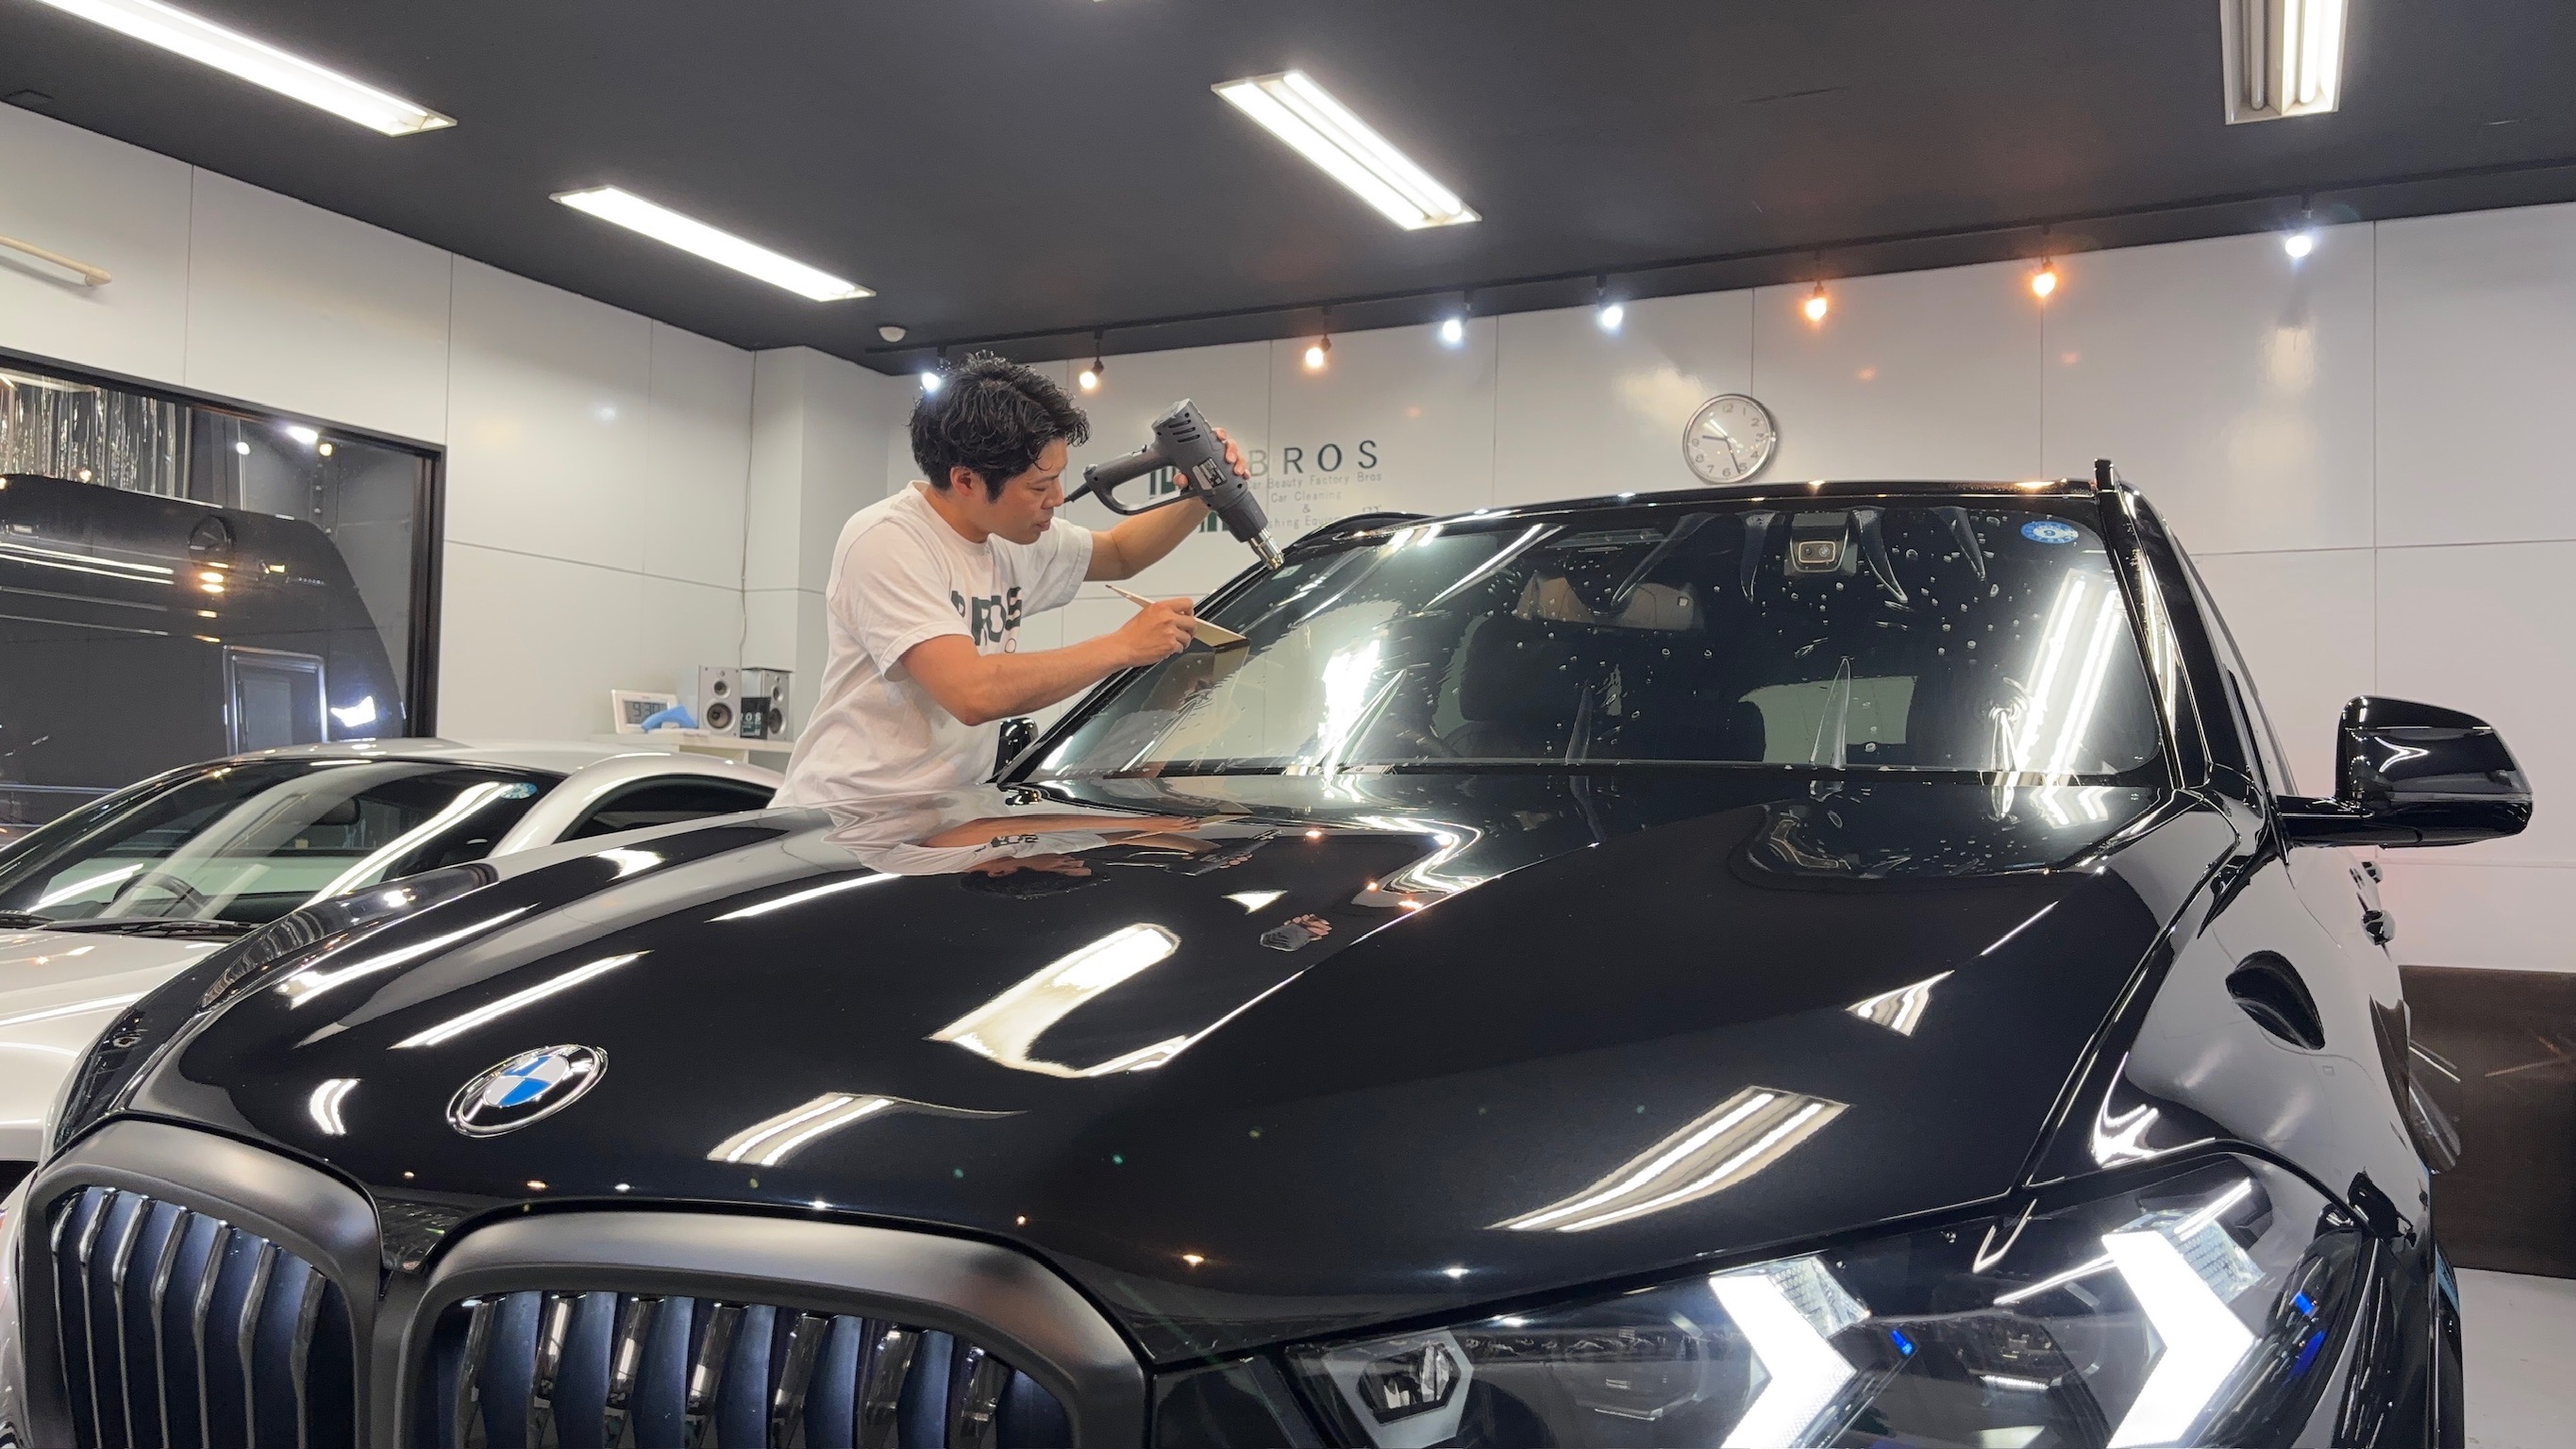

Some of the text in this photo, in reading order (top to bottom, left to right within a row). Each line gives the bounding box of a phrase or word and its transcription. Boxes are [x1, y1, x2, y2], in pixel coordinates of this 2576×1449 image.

[1750, 418, 1760, 426] 2
[1692, 438, 1699, 447] 9
[1248, 440, 1378, 476] BROS
[1707, 464, 1715, 474] 7
[1722, 468, 1731, 476] 6
[1738, 462, 1748, 472] 5
[1268, 477, 1303, 490] Beauty
[1310, 475, 1350, 486] Factory
[1357, 472, 1382, 483] Bros
[1270, 491, 1343, 503] Car Cleaning
[1301, 504, 1312, 514] &
